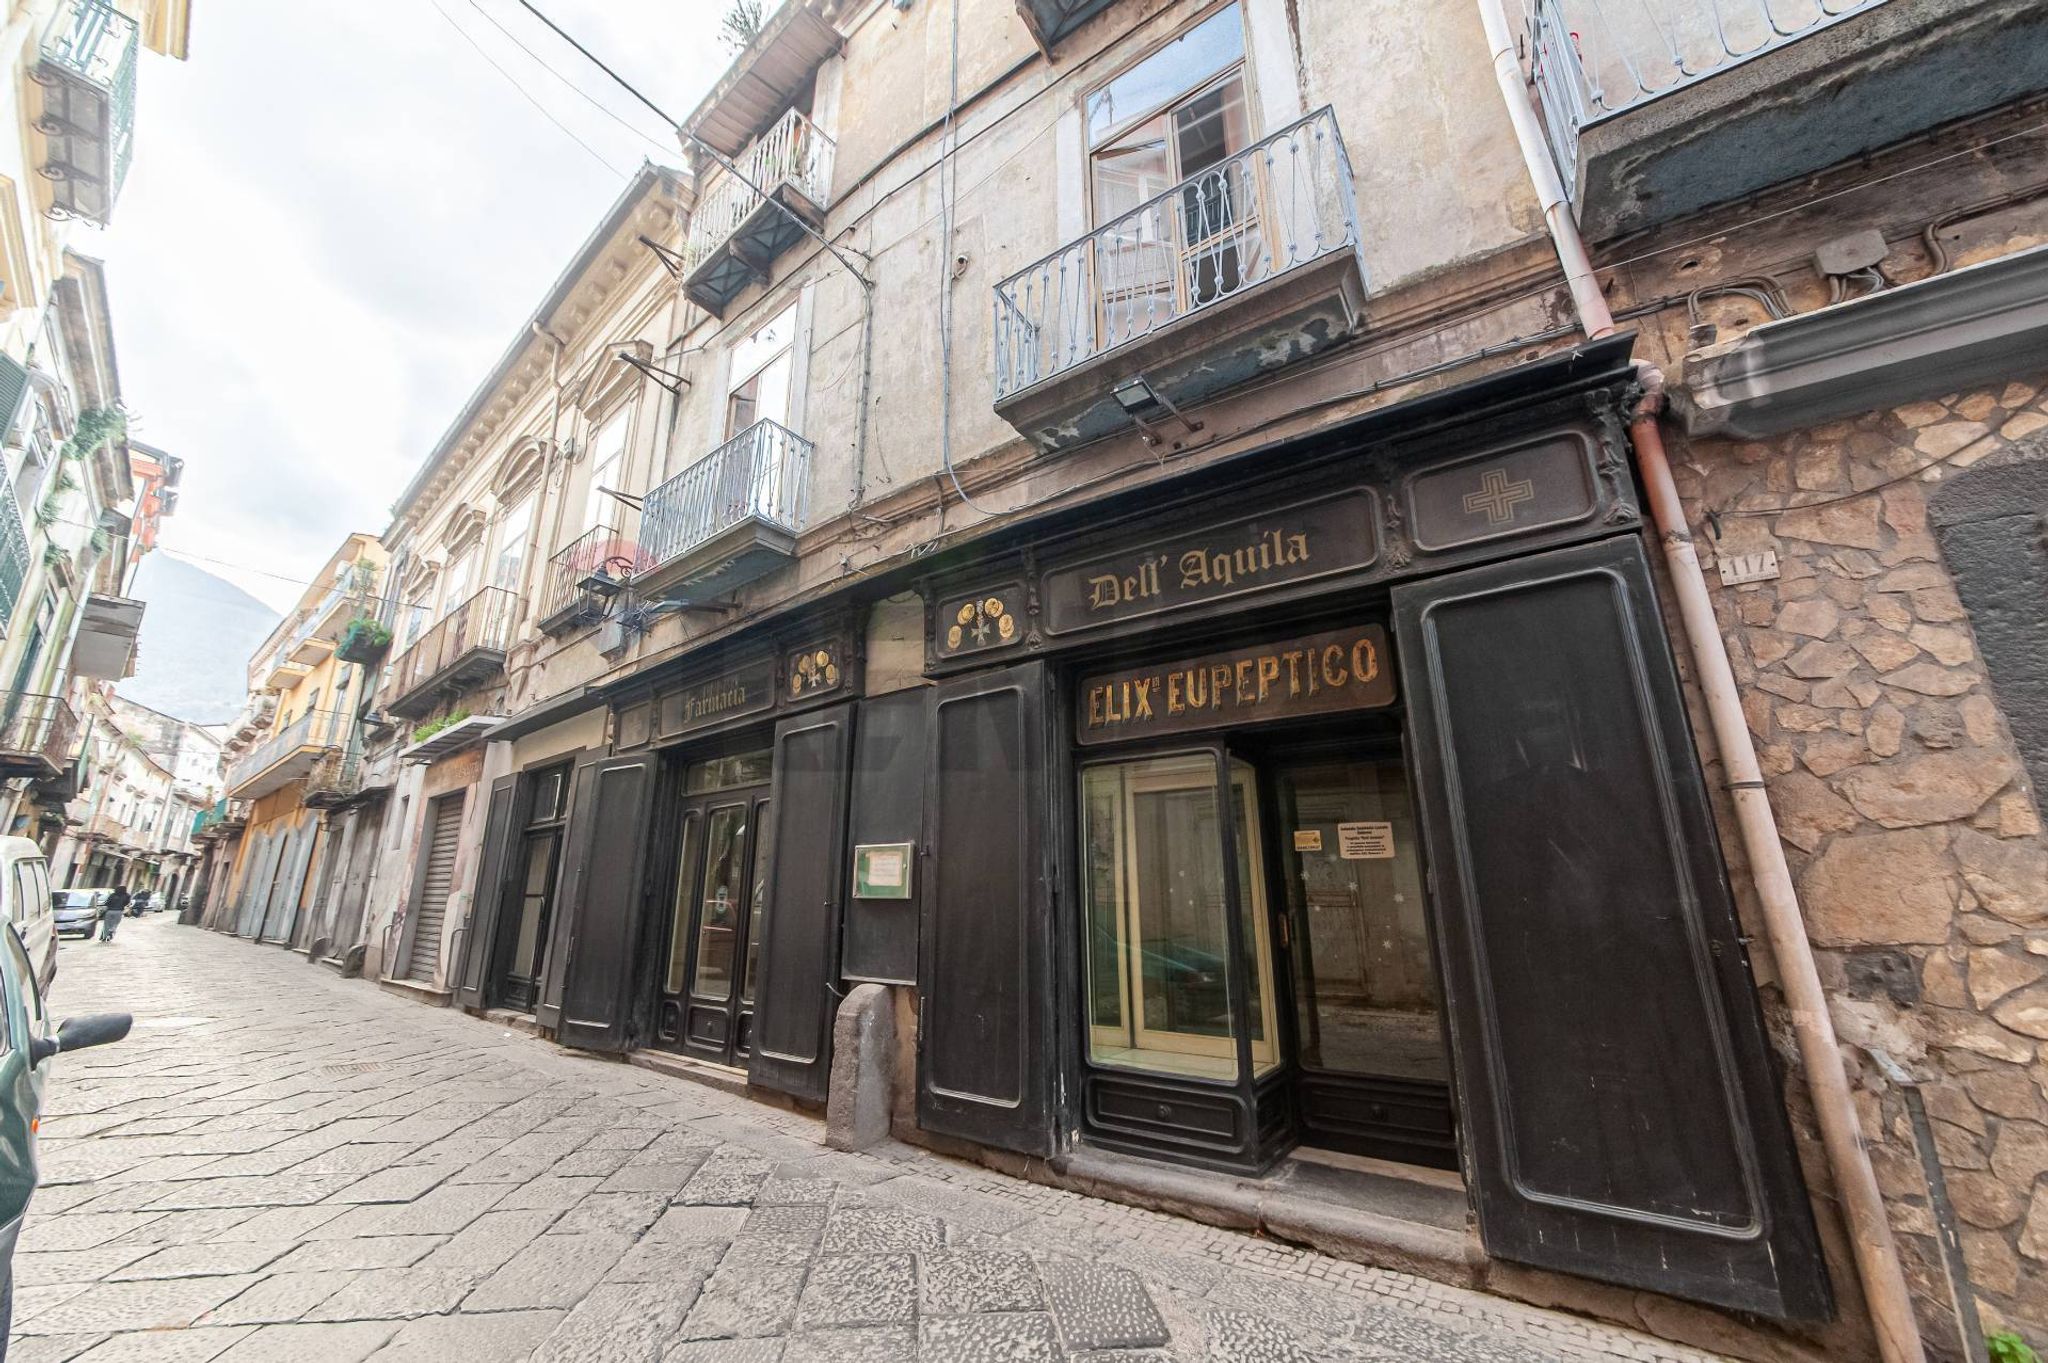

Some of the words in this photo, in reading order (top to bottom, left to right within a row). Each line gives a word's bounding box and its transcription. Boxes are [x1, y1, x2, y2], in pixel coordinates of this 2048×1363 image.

[1088, 554, 1168, 610] Dell'
[1178, 527, 1311, 589] Aquila
[683, 686, 746, 724] Farmacia
[1166, 637, 1381, 718] EUPEPTICO
